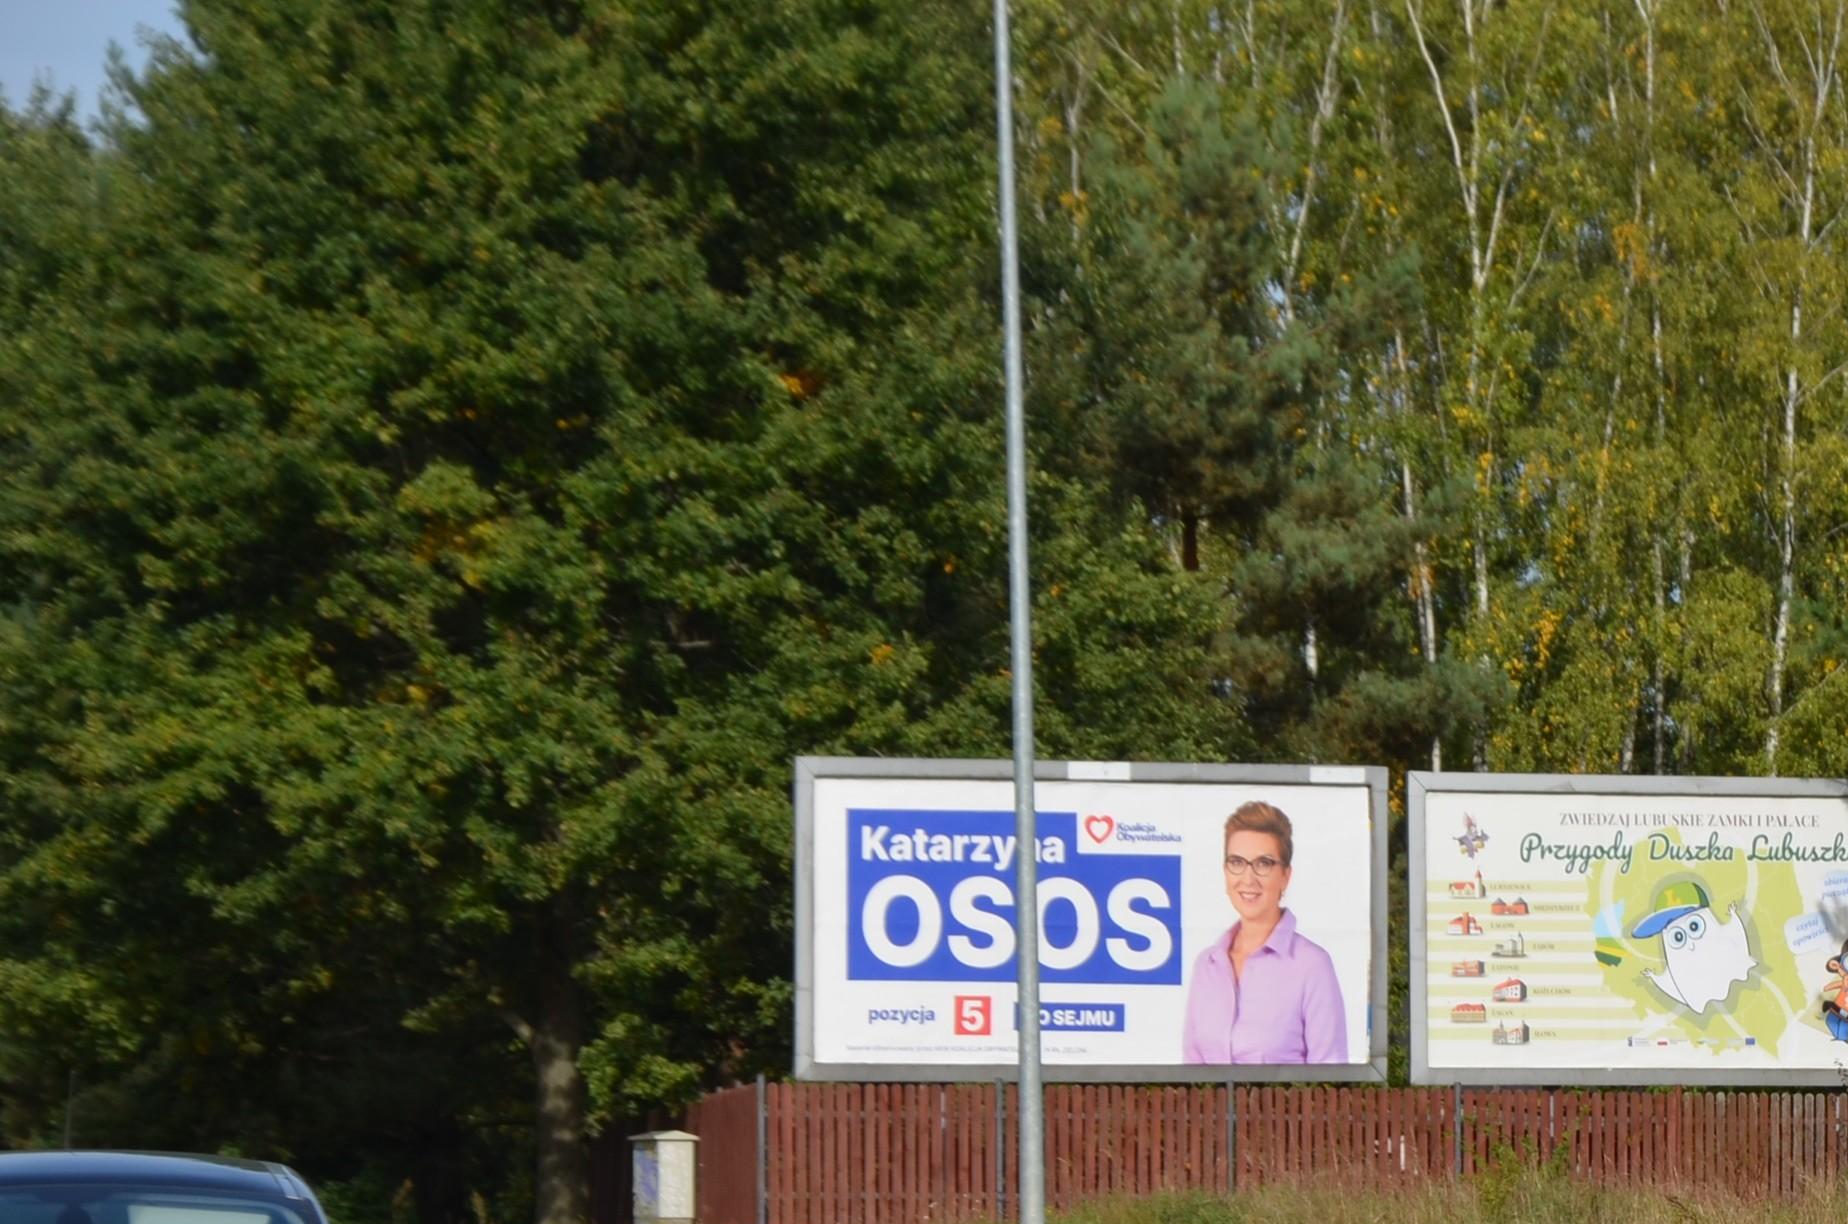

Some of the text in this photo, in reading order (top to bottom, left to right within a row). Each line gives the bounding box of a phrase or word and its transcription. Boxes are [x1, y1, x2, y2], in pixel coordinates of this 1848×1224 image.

[1560, 812, 1631, 827] ZWIEDZAJ
[1634, 813, 1705, 828] LUBUSKIE
[1708, 814, 1753, 828] ZAMKI
[1520, 830, 1633, 874] Przygody
[1648, 831, 1734, 861] Duszka
[861, 874, 1173, 971] OSOS
[867, 999, 985, 1032] pozycja 5
[1053, 1008, 1116, 1027] SEJMU
